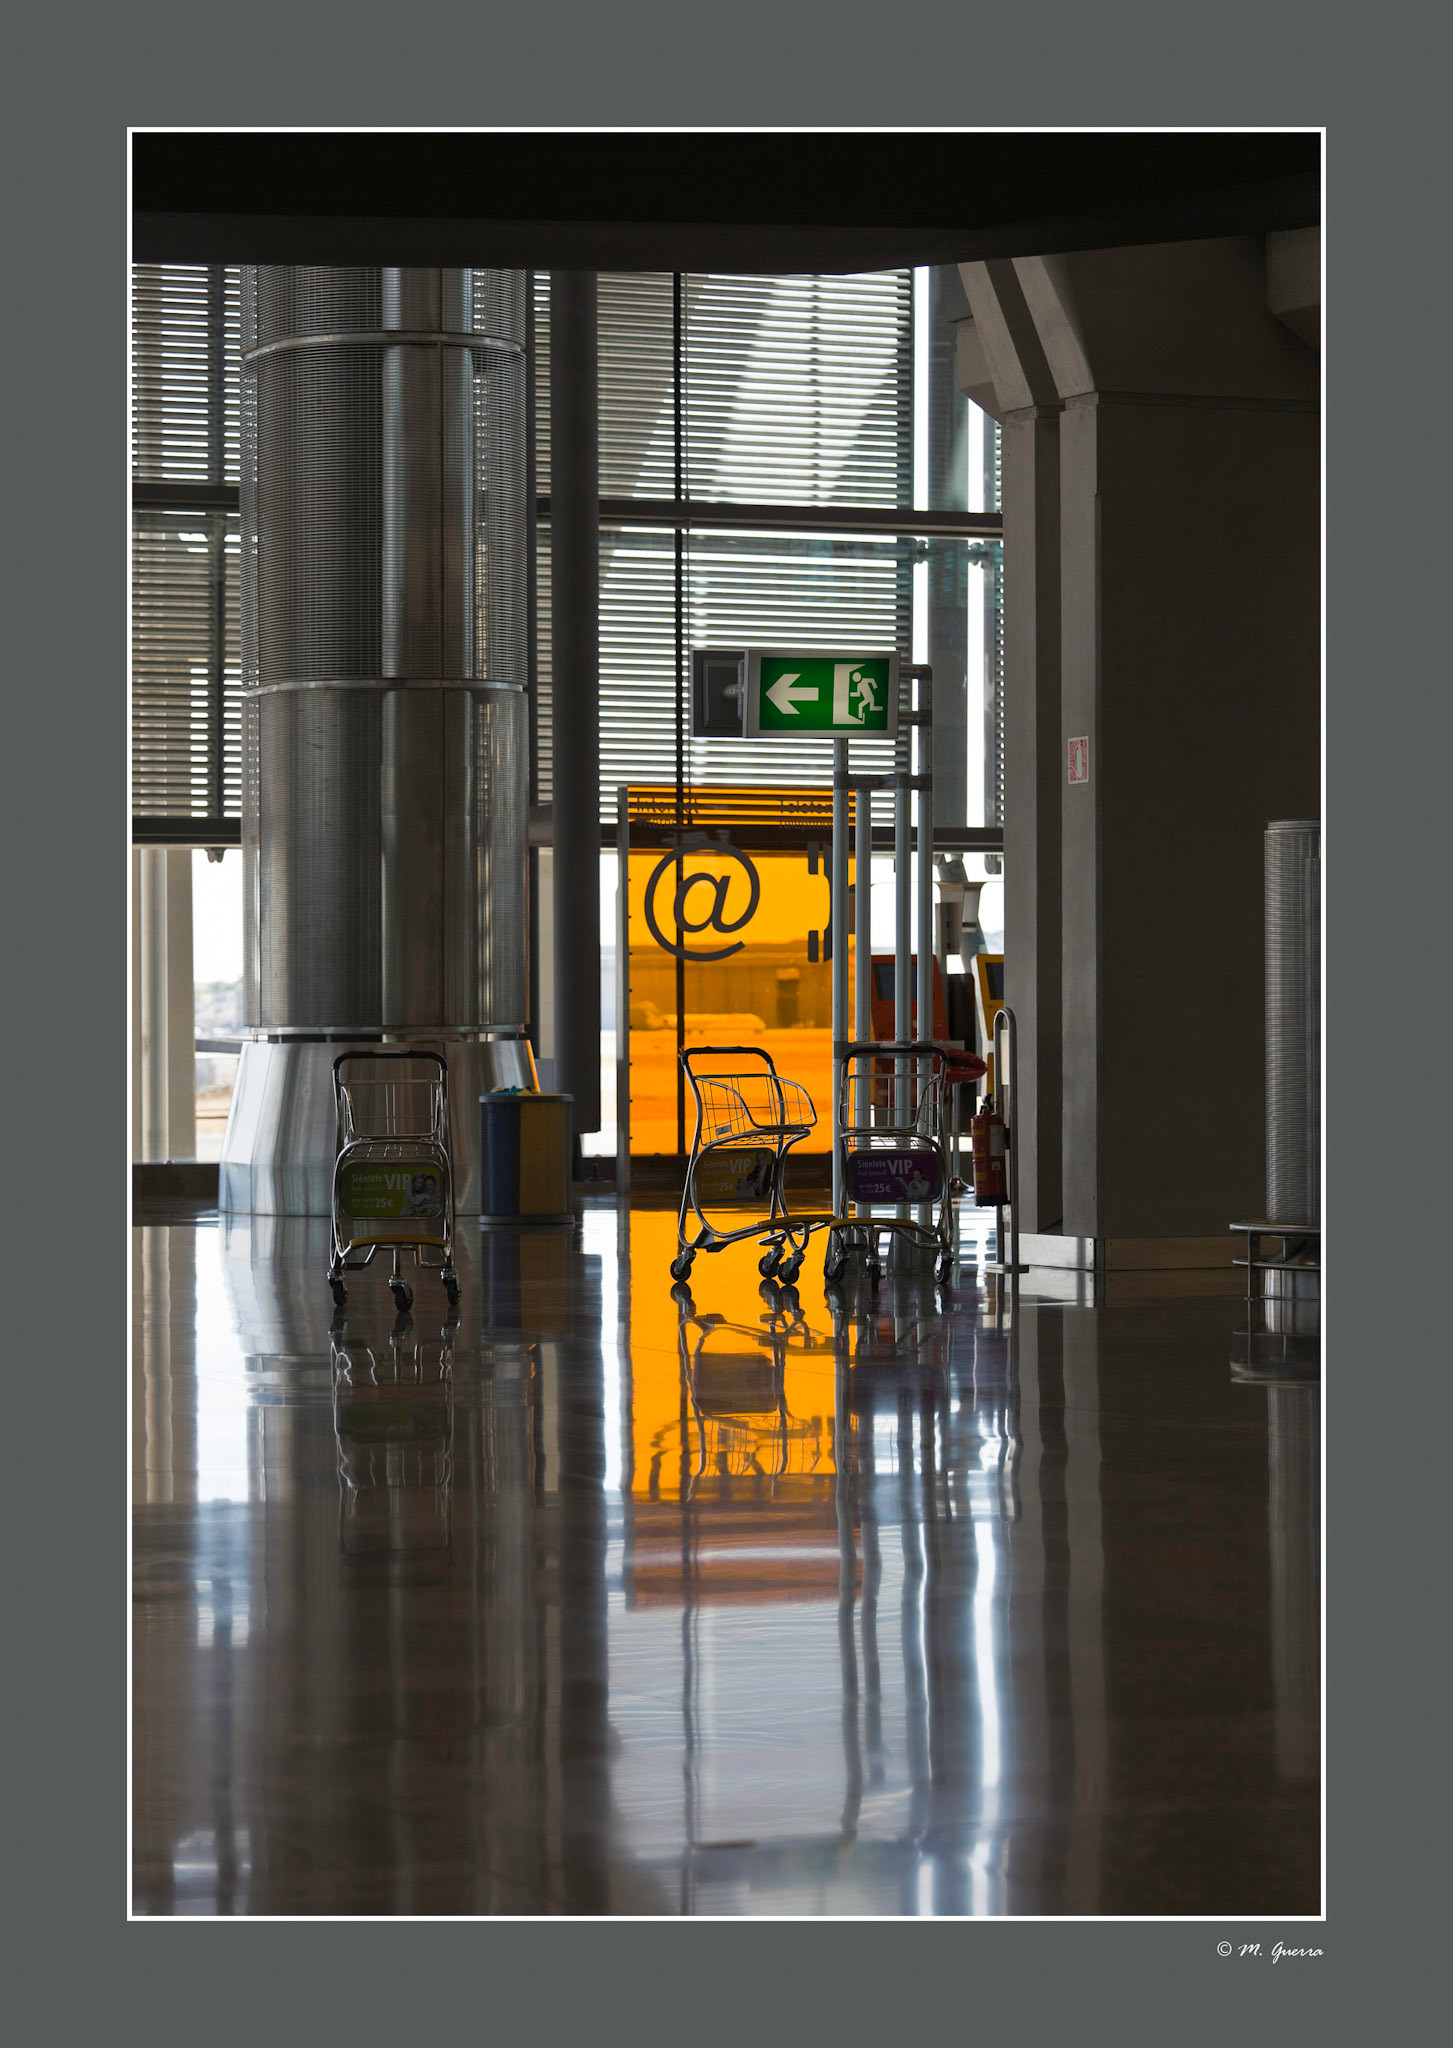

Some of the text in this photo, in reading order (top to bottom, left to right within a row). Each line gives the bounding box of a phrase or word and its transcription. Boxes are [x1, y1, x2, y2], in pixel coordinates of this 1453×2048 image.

[644, 840, 760, 962] @
[729, 1159, 752, 1175] VIP
[887, 1160, 914, 1175] VIP
[384, 1173, 412, 1190] VIP
